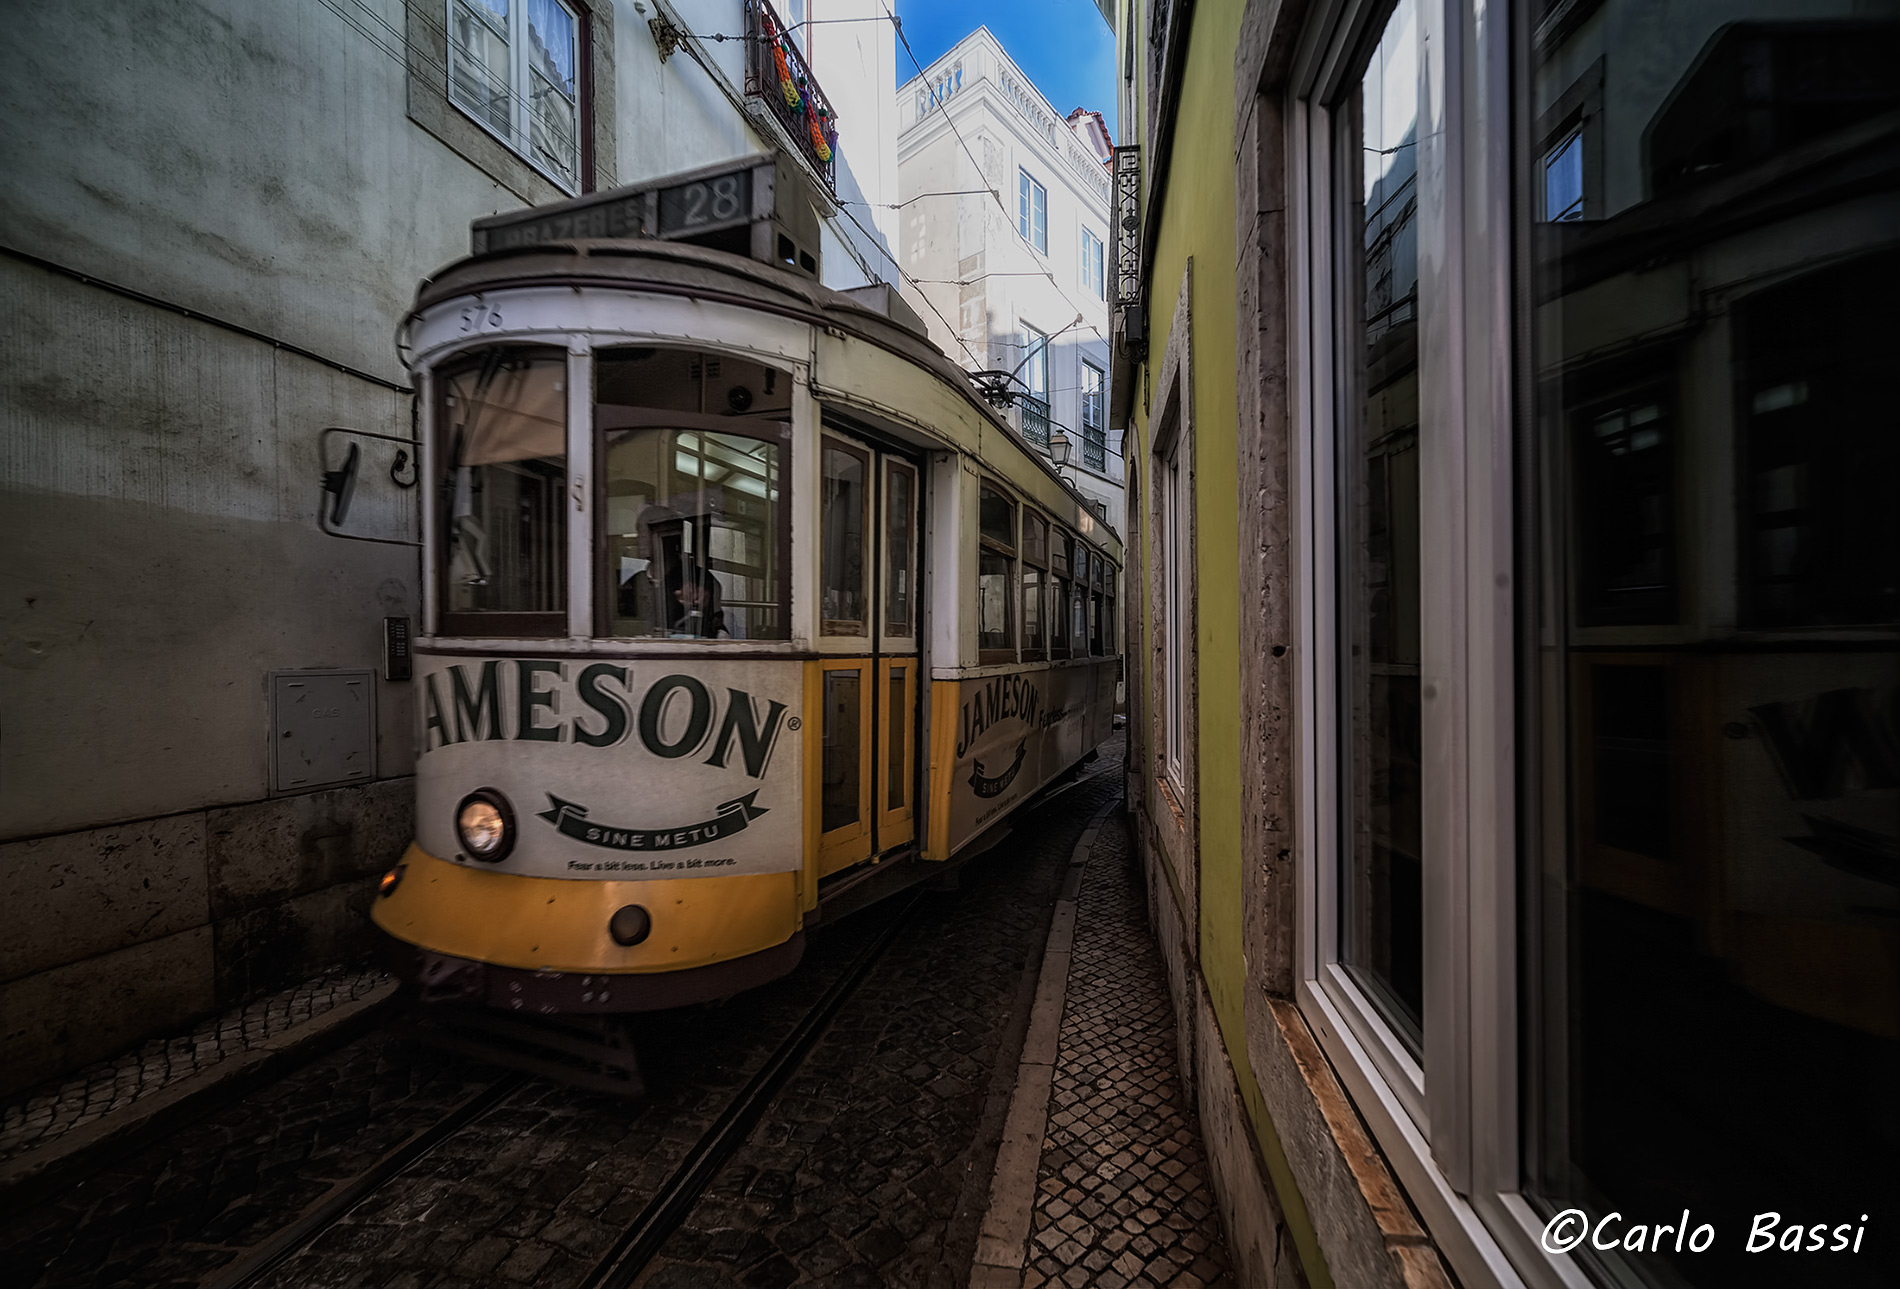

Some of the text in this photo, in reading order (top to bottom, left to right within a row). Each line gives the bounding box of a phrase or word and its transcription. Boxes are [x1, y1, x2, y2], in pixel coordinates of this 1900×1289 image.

[684, 175, 739, 226] 28
[460, 302, 504, 333] 576
[312, 707, 341, 719] GAS
[956, 674, 1039, 759] JAMESON
[585, 824, 720, 848] SINE METU
[567, 860, 593, 871] Fear
[604, 860, 620, 871] bit
[621, 860, 648, 871] less.
[650, 859, 675, 871] Live
[676, 862, 685, 870] a
[686, 858, 703, 870] bit
[704, 857, 737, 868] more.
